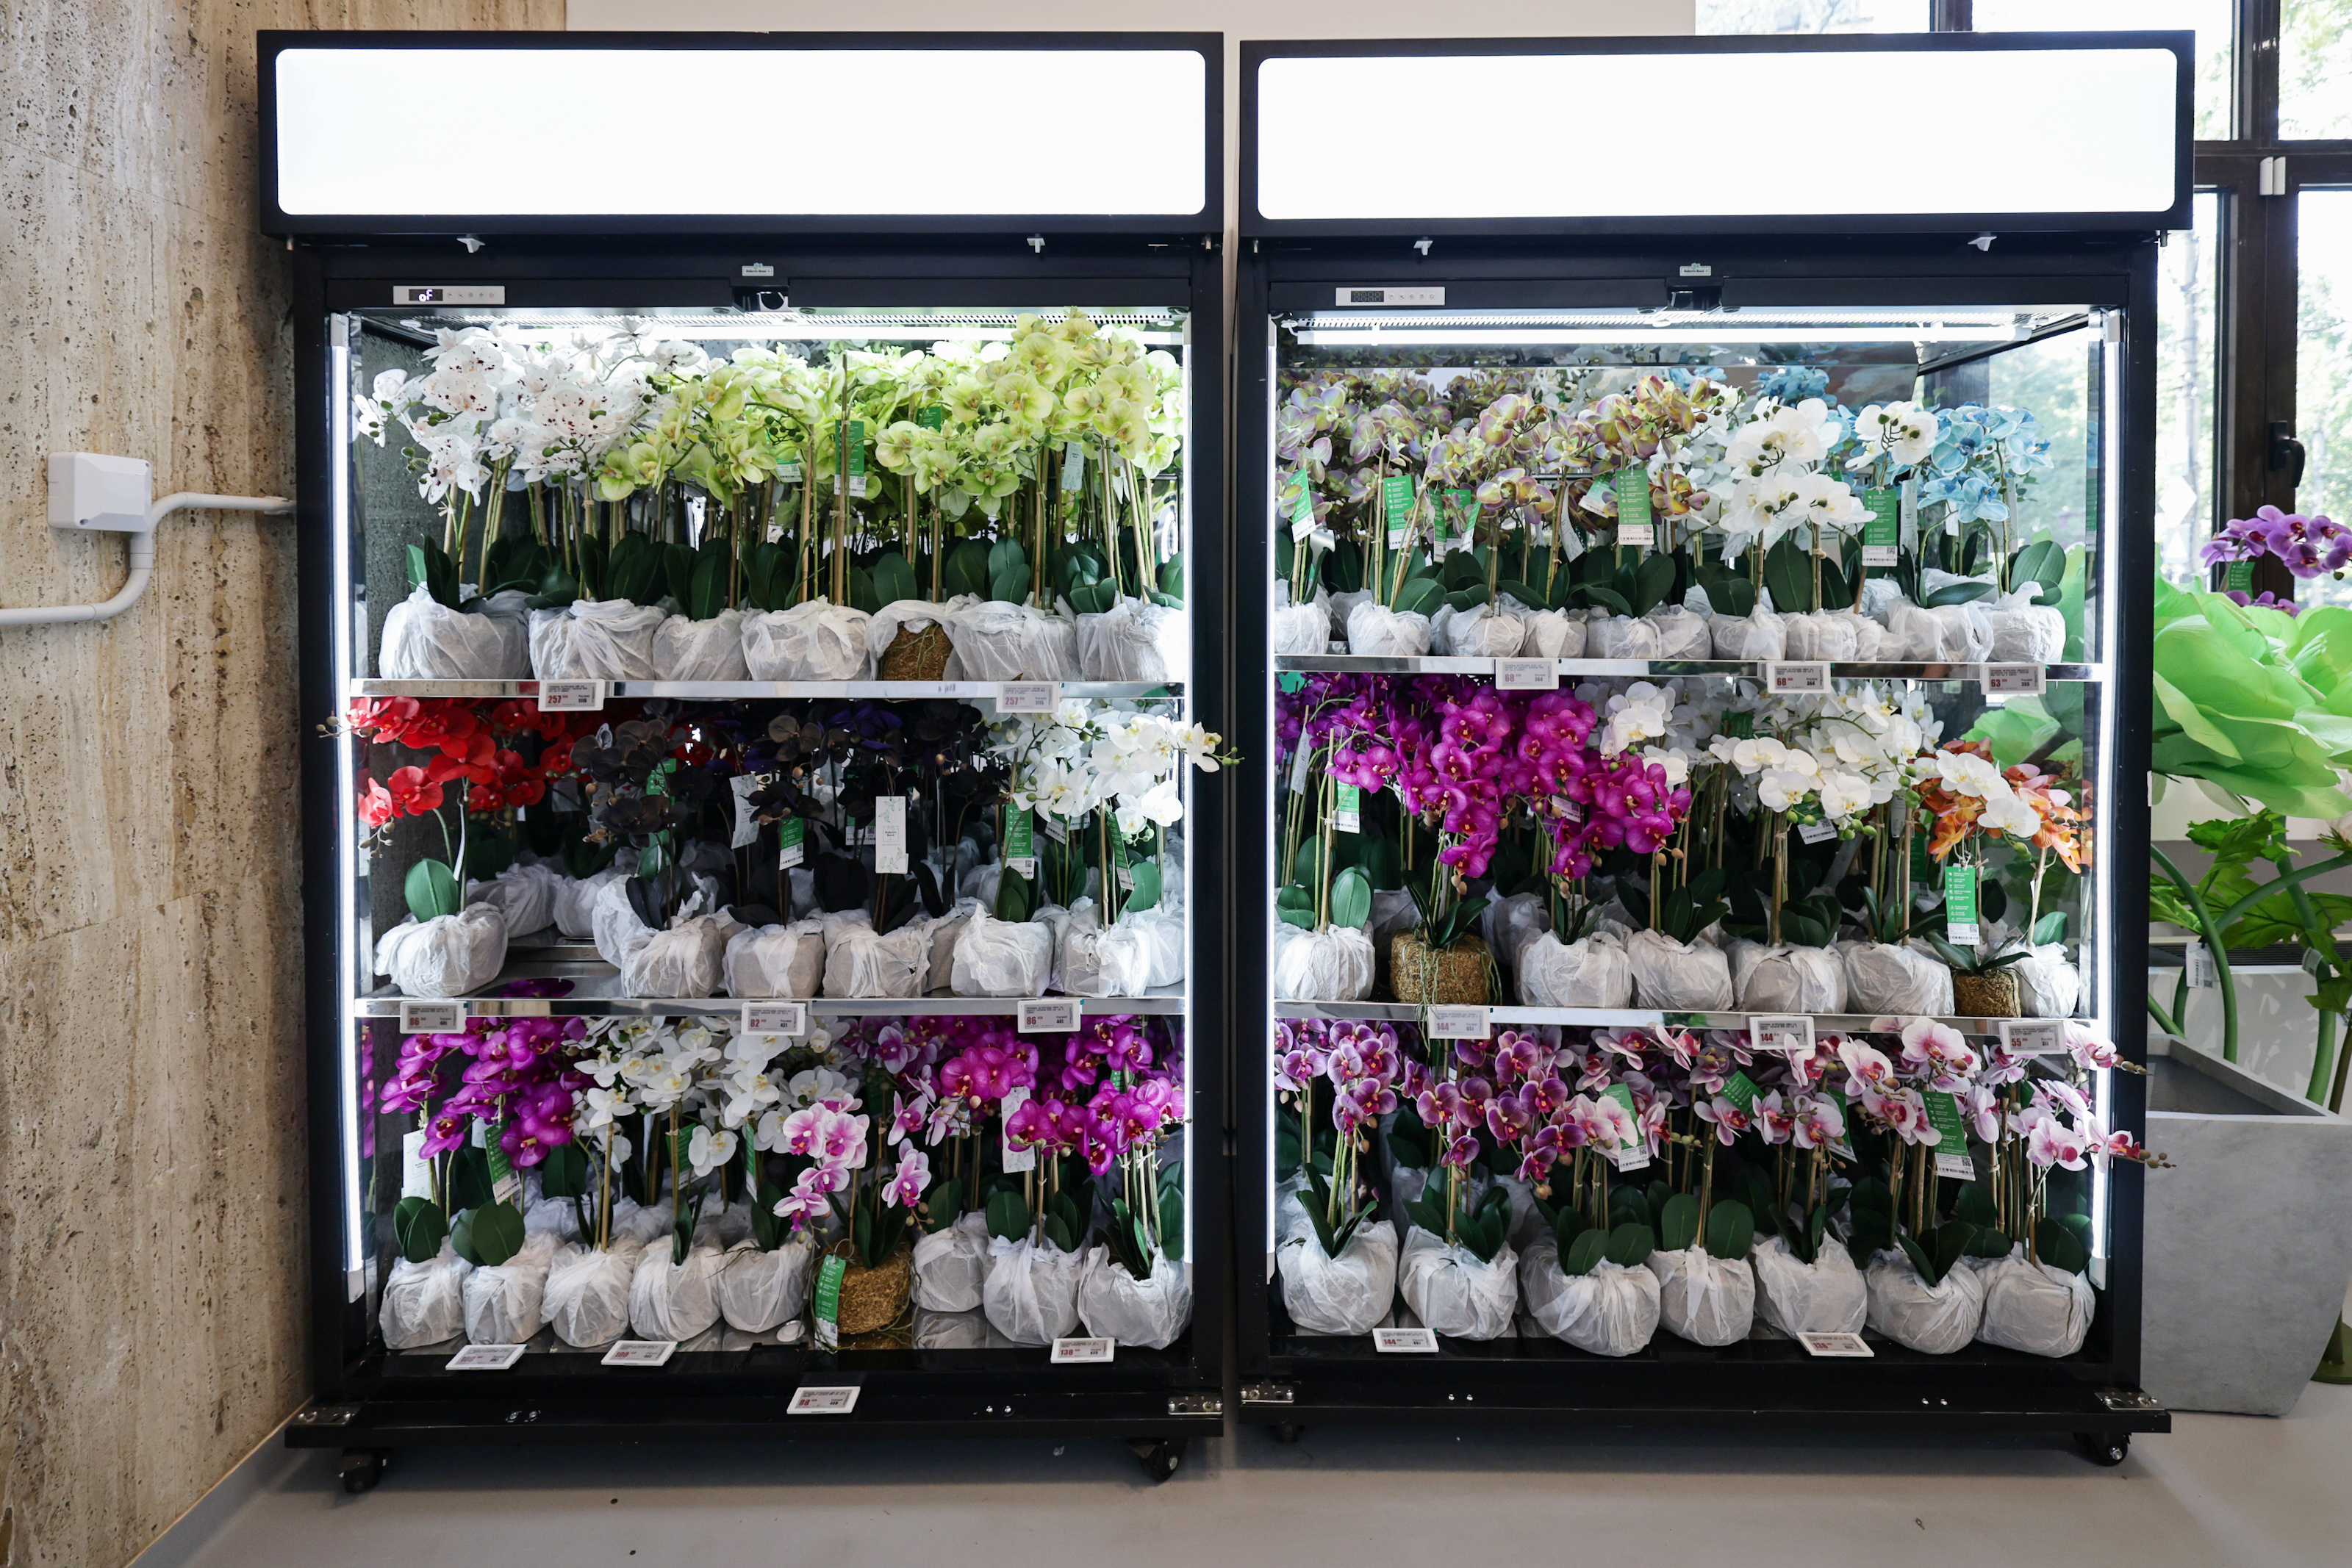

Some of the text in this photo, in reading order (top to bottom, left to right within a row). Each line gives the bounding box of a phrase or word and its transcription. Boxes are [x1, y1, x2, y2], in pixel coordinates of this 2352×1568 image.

[1505, 674, 1514, 682] 68
[1777, 678, 1786, 686] 68
[548, 695, 561, 703] 257
[1005, 697, 1018, 705] 257
[750, 1019, 760, 1027] 82
[1027, 1017, 1036, 1025] 86
[1437, 1023, 1449, 1031] 144
[2012, 1038, 2021, 1046] 55
